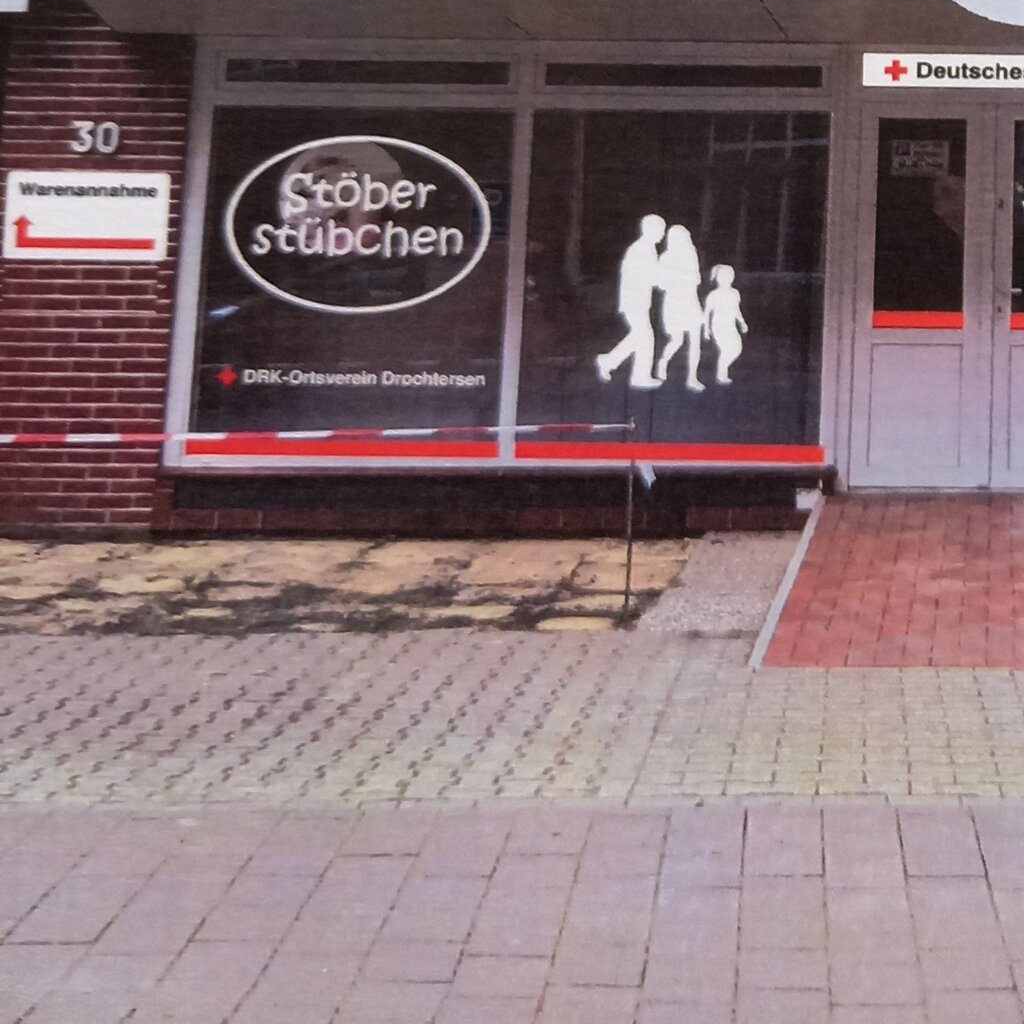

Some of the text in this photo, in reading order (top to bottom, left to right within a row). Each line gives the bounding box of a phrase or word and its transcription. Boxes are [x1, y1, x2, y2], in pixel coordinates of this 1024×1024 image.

[70, 120, 120, 154] 30
[19, 181, 158, 198] Warenannahme
[281, 171, 437, 220] Stöber
[243, 369, 486, 386] DRK-Ortsverein Drochtersen
